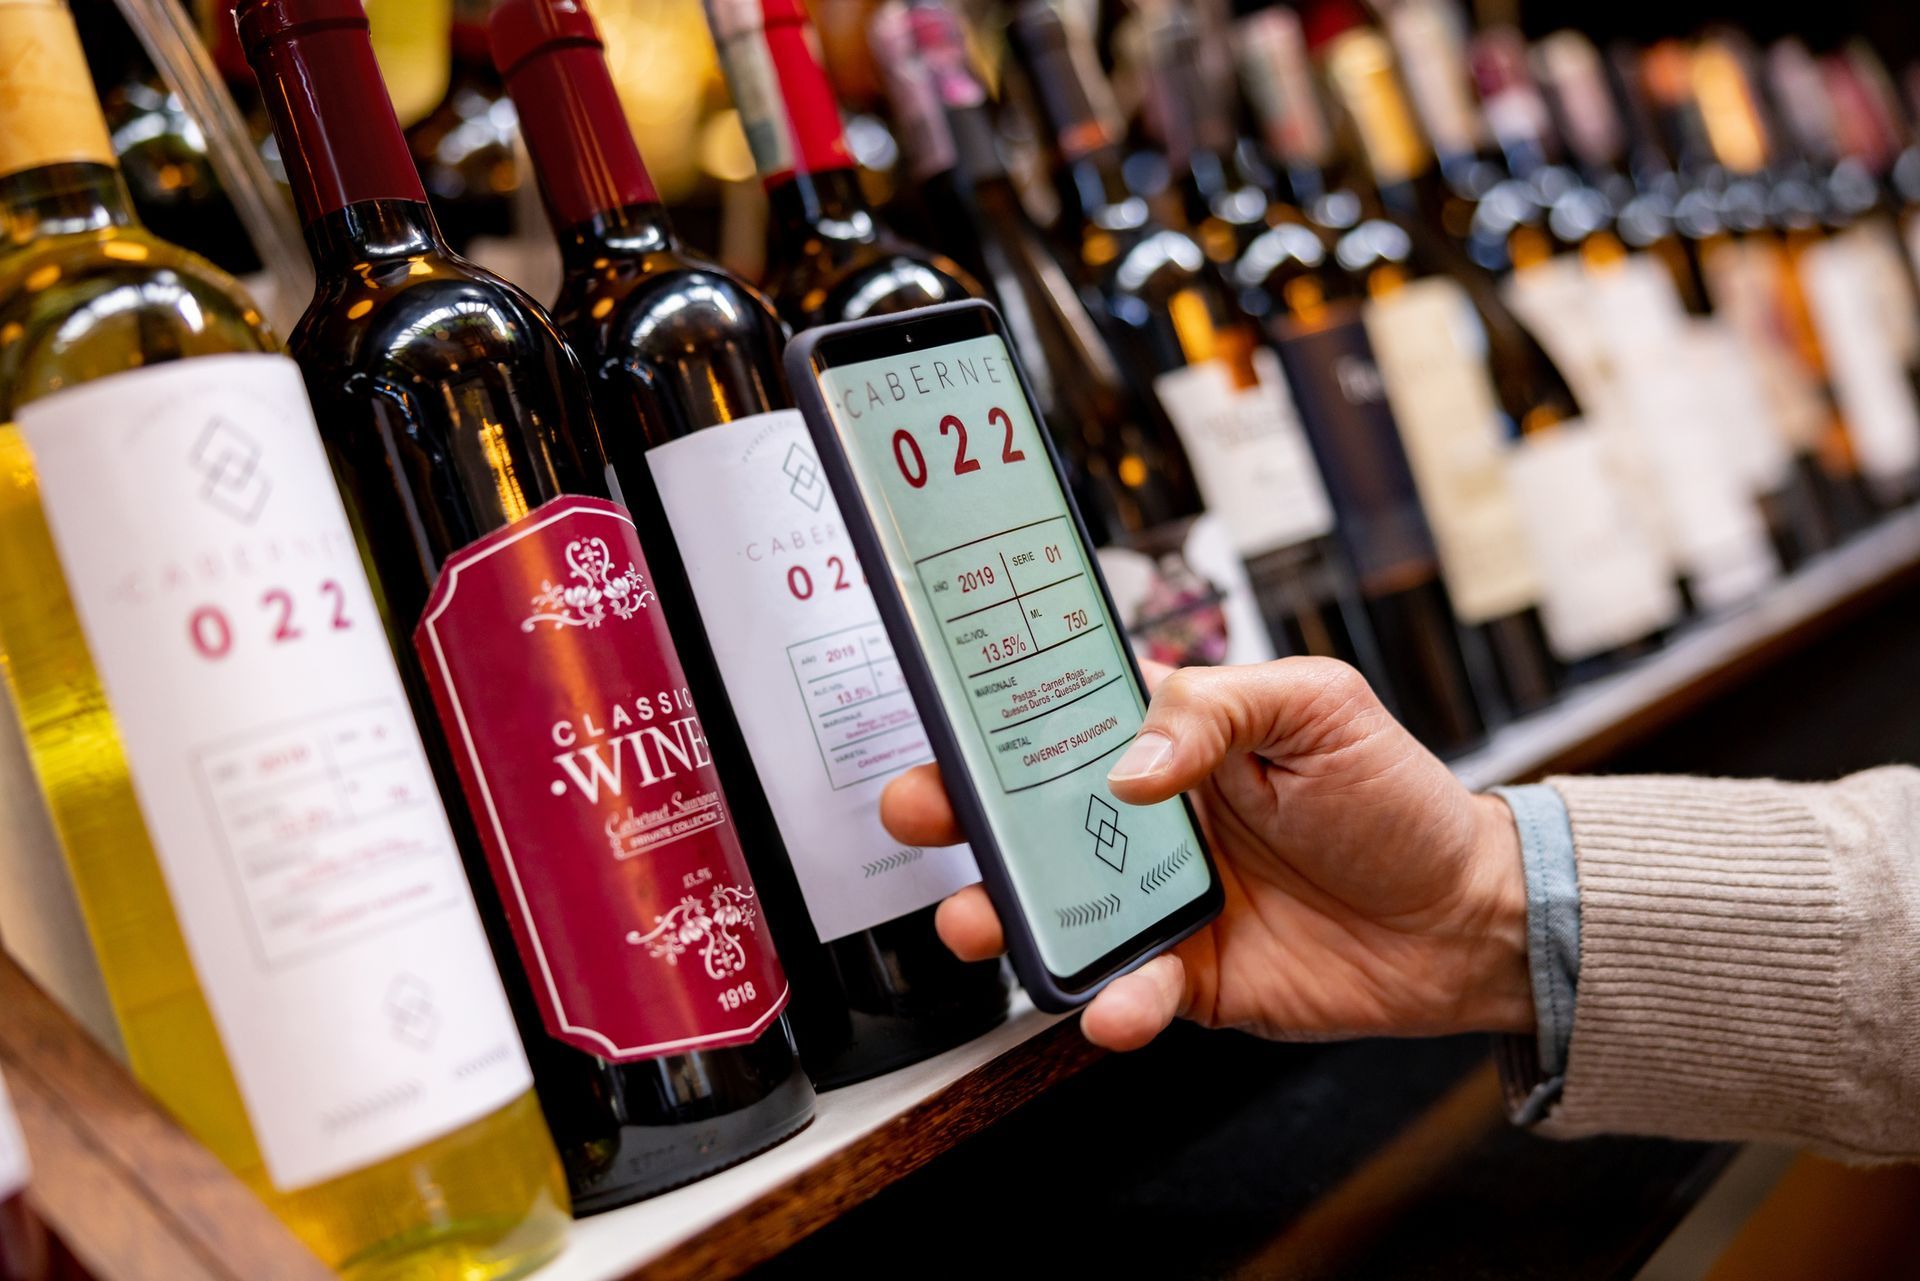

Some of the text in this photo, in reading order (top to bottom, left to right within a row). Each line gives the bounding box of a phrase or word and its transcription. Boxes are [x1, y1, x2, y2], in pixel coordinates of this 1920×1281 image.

[1012, 544, 1062, 567] SERIE 01
[787, 551, 868, 600] 02
[958, 566, 995, 593] 2019
[1030, 608, 1088, 632] ML 750
[982, 633, 1027, 663] 13.5%
[1001, 704, 1028, 719] Quesos
[1029, 694, 1051, 709] Duros
[1055, 682, 1080, 699] Quesos
[1080, 669, 1105, 687] Blandos
[1012, 688, 1037, 703] Pastas
[1065, 669, 1085, 683] Rojas
[552, 687, 692, 747] CLASSIC
[996, 736, 1032, 753] VARIETAL
[1022, 716, 1118, 767] CAVERNET SAUVIGNON
[717, 981, 757, 1012] 1918
